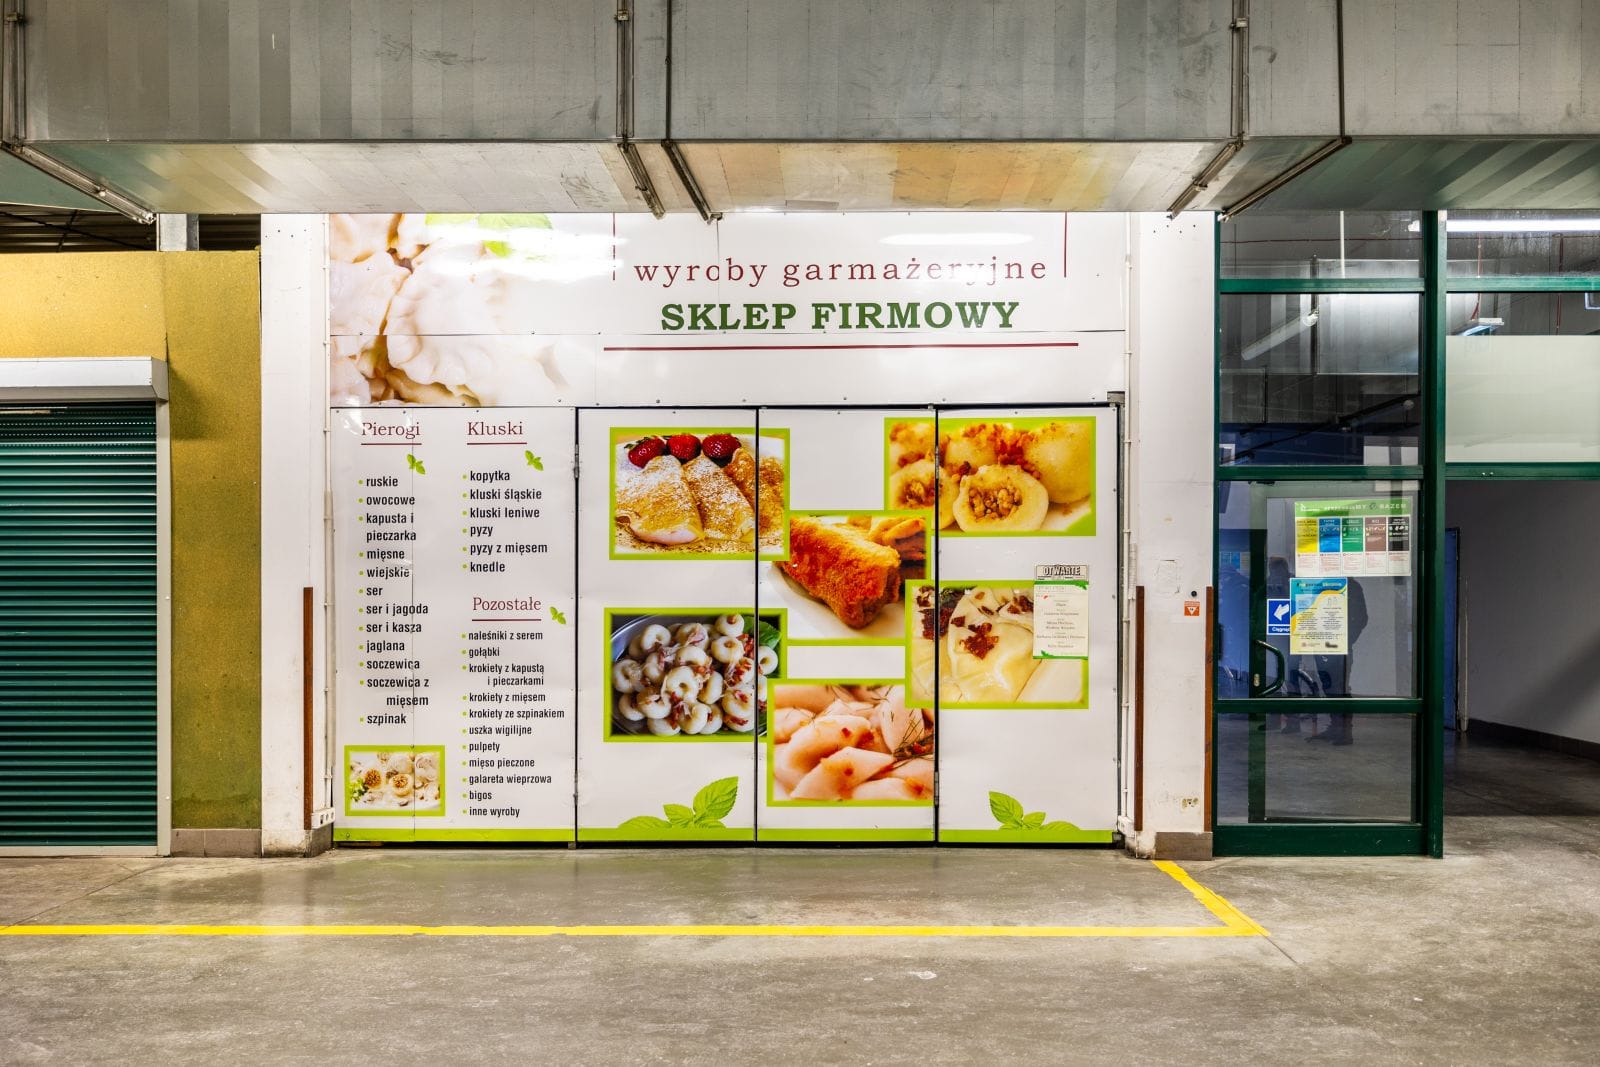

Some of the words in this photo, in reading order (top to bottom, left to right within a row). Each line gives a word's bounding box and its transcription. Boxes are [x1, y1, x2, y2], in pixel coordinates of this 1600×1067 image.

[634, 258, 768, 289] wyroby
[661, 303, 796, 331] SKLEP
[811, 301, 1020, 329] FIRMOWY
[361, 421, 421, 439] Pierogi
[467, 421, 524, 436] Kluski
[366, 476, 398, 487] ruskie
[470, 470, 510, 483] kopytka
[366, 495, 415, 505] owocowe
[470, 489, 501, 500] kluski
[504, 489, 542, 502] śląskie
[470, 507, 501, 518] kluski
[504, 507, 540, 518] leniwe
[366, 513, 407, 526] kapusta
[410, 513, 414, 524] i
[366, 530, 417, 543] pieczarka
[470, 526, 493, 537] pyzy
[470, 544, 493, 555] pyzy
[496, 544, 502, 553] z
[504, 542, 548, 556] mięsem
[367, 549, 405, 562] mięsne
[470, 561, 505, 572] knedle
[1043, 566, 1081, 576] OTWARTE
[367, 567, 410, 580] wiejskie
[366, 586, 383, 596] ser
[366, 605, 383, 614] ser
[385, 604, 389, 614] i
[392, 603, 429, 617] jagoda
[472, 597, 542, 611] Pozostałe
[366, 623, 383, 633] ser
[385, 622, 389, 633] i
[392, 622, 422, 633] kasza
[468, 631, 507, 641] naleśniki
[509, 632, 514, 640] z
[516, 632, 543, 640] serem
[366, 640, 405, 653] jaglana
[469, 647, 500, 659] gołąbki
[366, 659, 420, 669] soczewica
[469, 664, 503, 675] krokiety
[505, 665, 509, 673] z
[511, 663, 545, 675] kapustą
[367, 677, 421, 688] soczewica
[424, 678, 430, 688] z
[487, 676, 490, 686] i
[492, 676, 544, 687] pieczarkami
[386, 695, 429, 709] mięsem
[469, 693, 503, 704] krokiety
[505, 694, 510, 702] z
[512, 692, 546, 704] mięsem
[367, 713, 407, 727] szpinak
[469, 709, 503, 720] krokiety
[505, 710, 514, 718] ze
[516, 709, 565, 720] szpinakiem
[469, 725, 493, 735] uszka
[495, 725, 532, 737] wigilijne
[469, 742, 500, 753] pulpety
[469, 758, 495, 770] mięso
[497, 758, 535, 769] pieczone
[469, 774, 504, 786] galareta
[506, 774, 552, 785] wieprzowa
[469, 791, 493, 802] bigos
[469, 807, 488, 816] inne
[490, 807, 520, 818] wyroby
